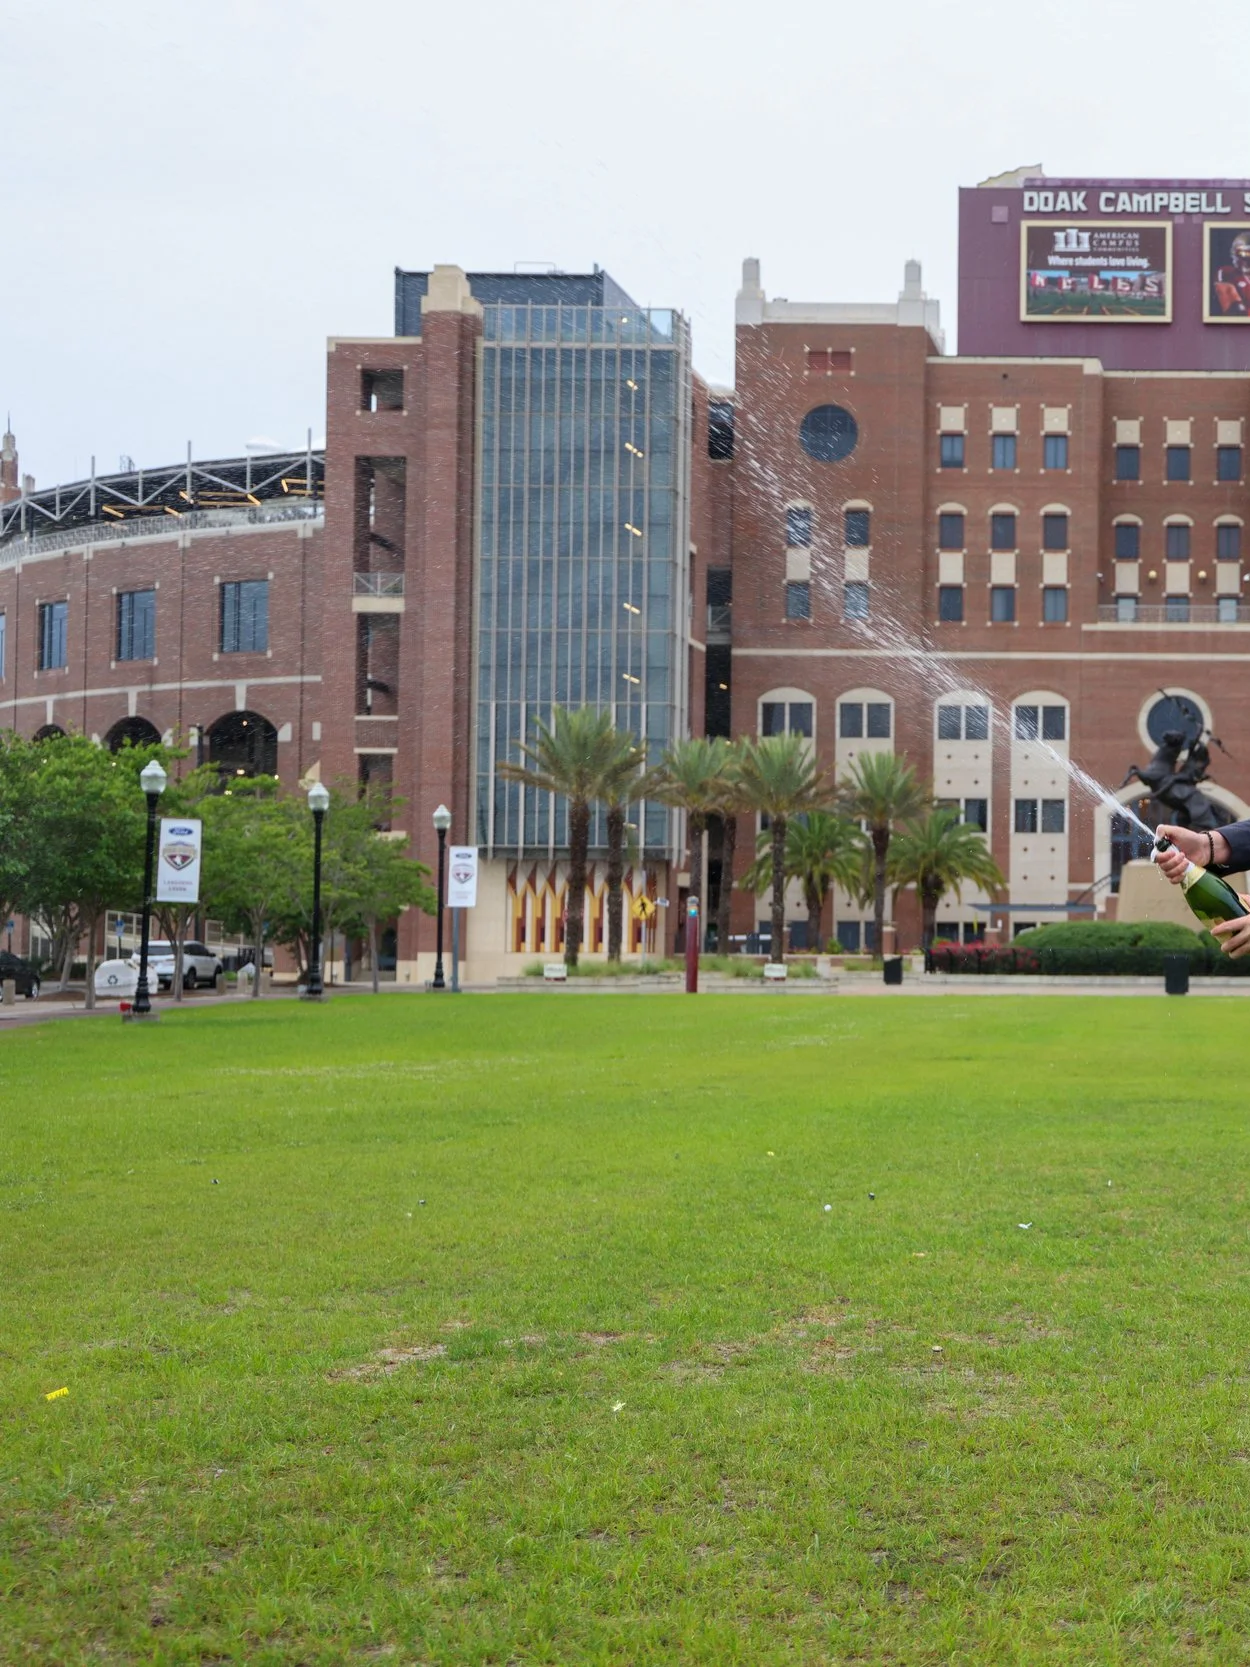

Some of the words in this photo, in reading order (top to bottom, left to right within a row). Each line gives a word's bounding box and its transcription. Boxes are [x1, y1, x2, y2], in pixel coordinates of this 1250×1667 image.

[1023, 191, 1088, 212] DOAK
[1099, 192, 1231, 214] CAMPBELL
[1047, 255, 1074, 266] Where
[1075, 256, 1107, 266] students
[1109, 256, 1125, 266] love
